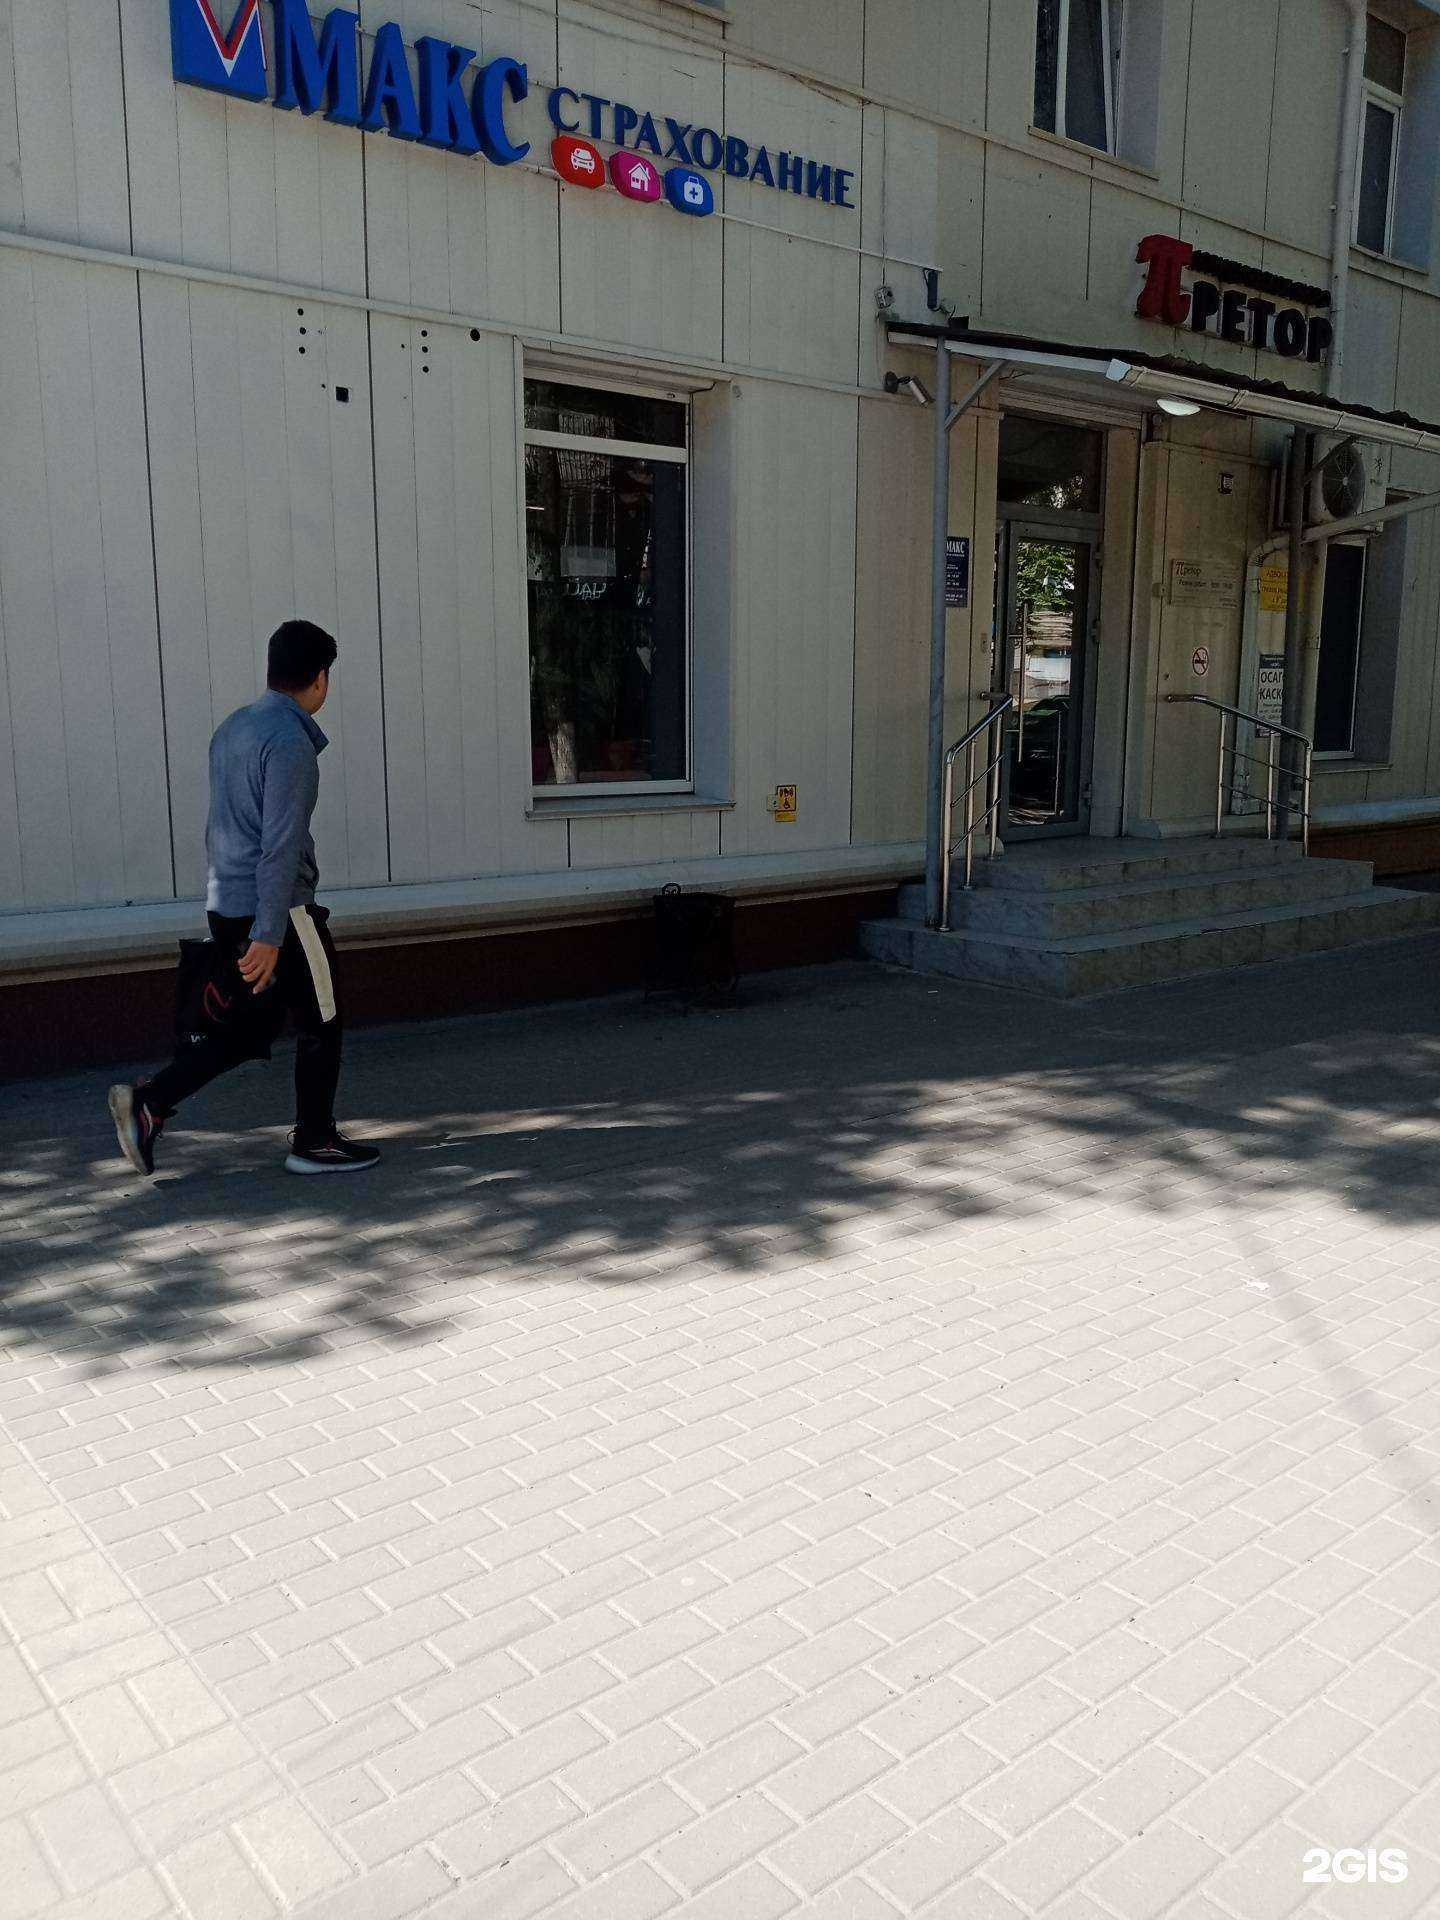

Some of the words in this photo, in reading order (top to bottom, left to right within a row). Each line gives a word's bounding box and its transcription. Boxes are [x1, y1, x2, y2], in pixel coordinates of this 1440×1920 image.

[272, 0, 532, 166] МАКС
[548, 86, 856, 209] СТРАХОВАНИЕ
[946, 540, 965, 554] МАКС
[1260, 671, 1283, 683] ОСАГ
[1259, 687, 1282, 700] КАСК
